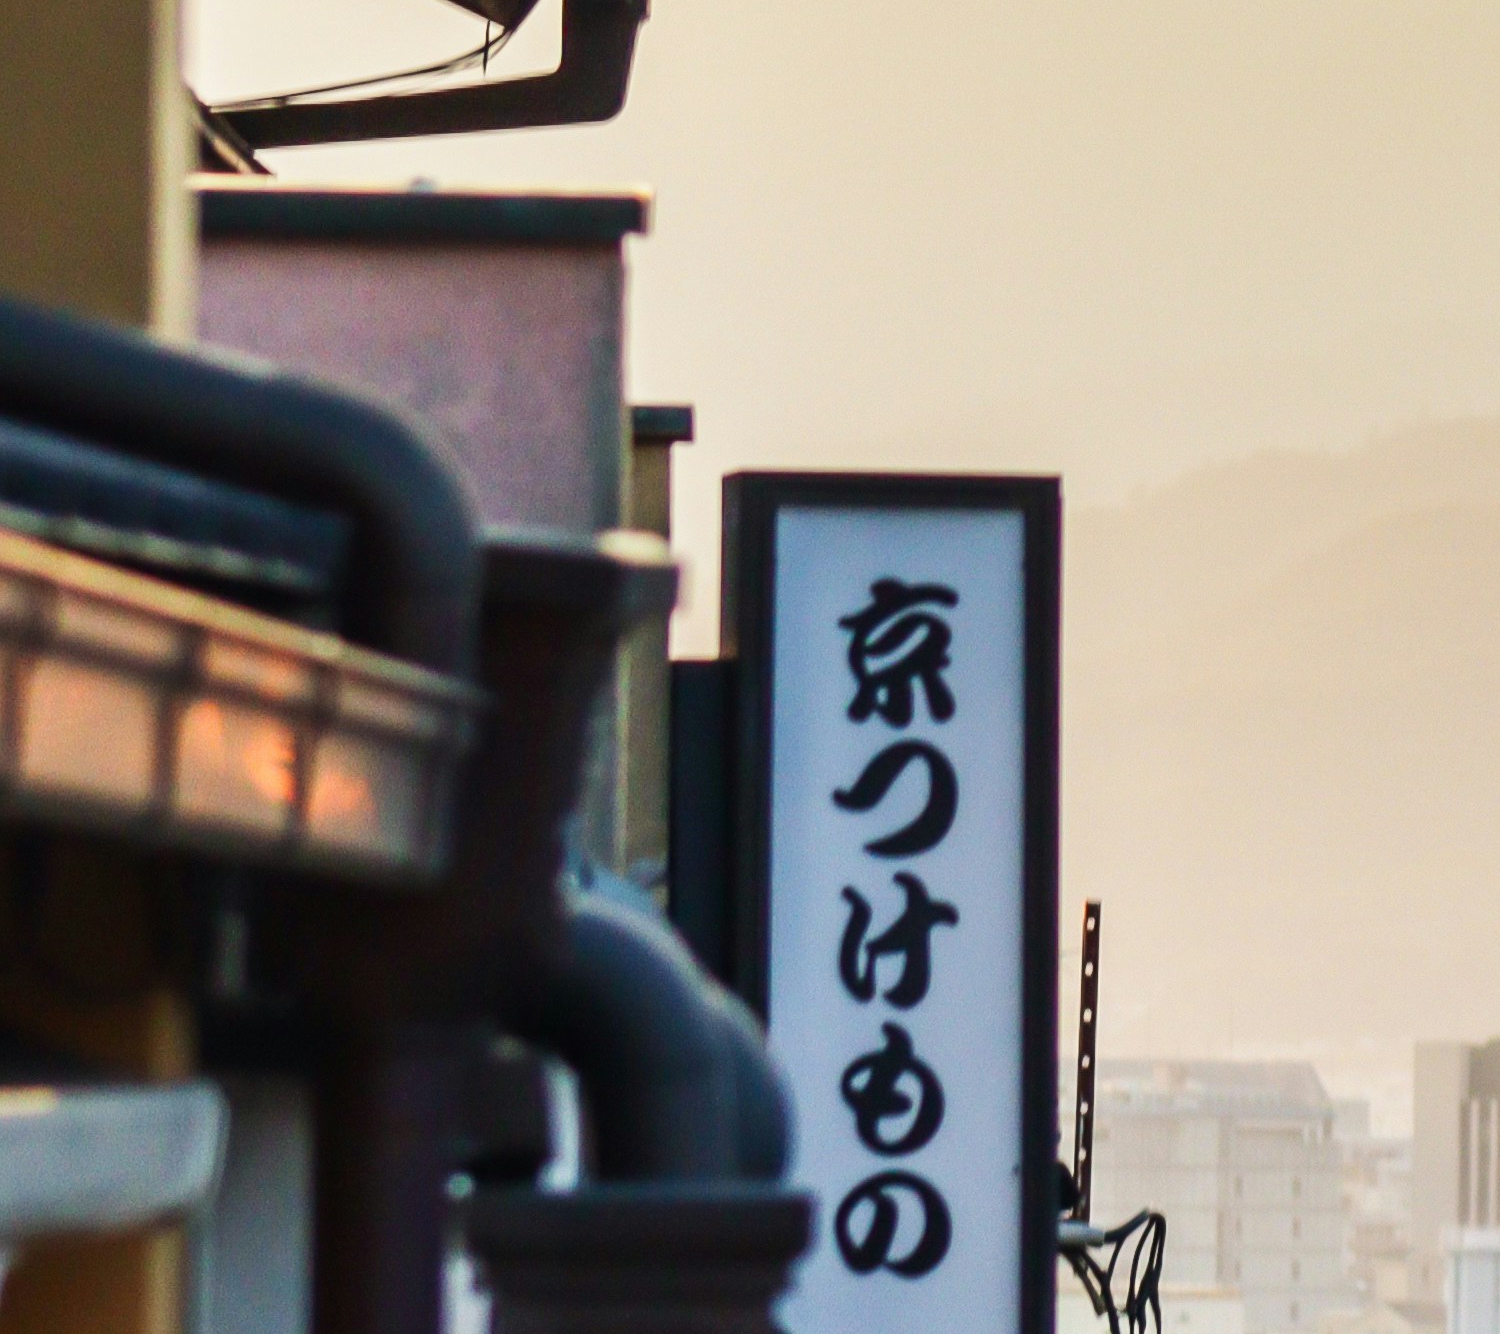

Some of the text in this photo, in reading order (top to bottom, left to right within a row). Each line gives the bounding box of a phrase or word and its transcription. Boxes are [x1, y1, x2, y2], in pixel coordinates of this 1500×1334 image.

[833, 575, 961, 1281] 京つけもの
